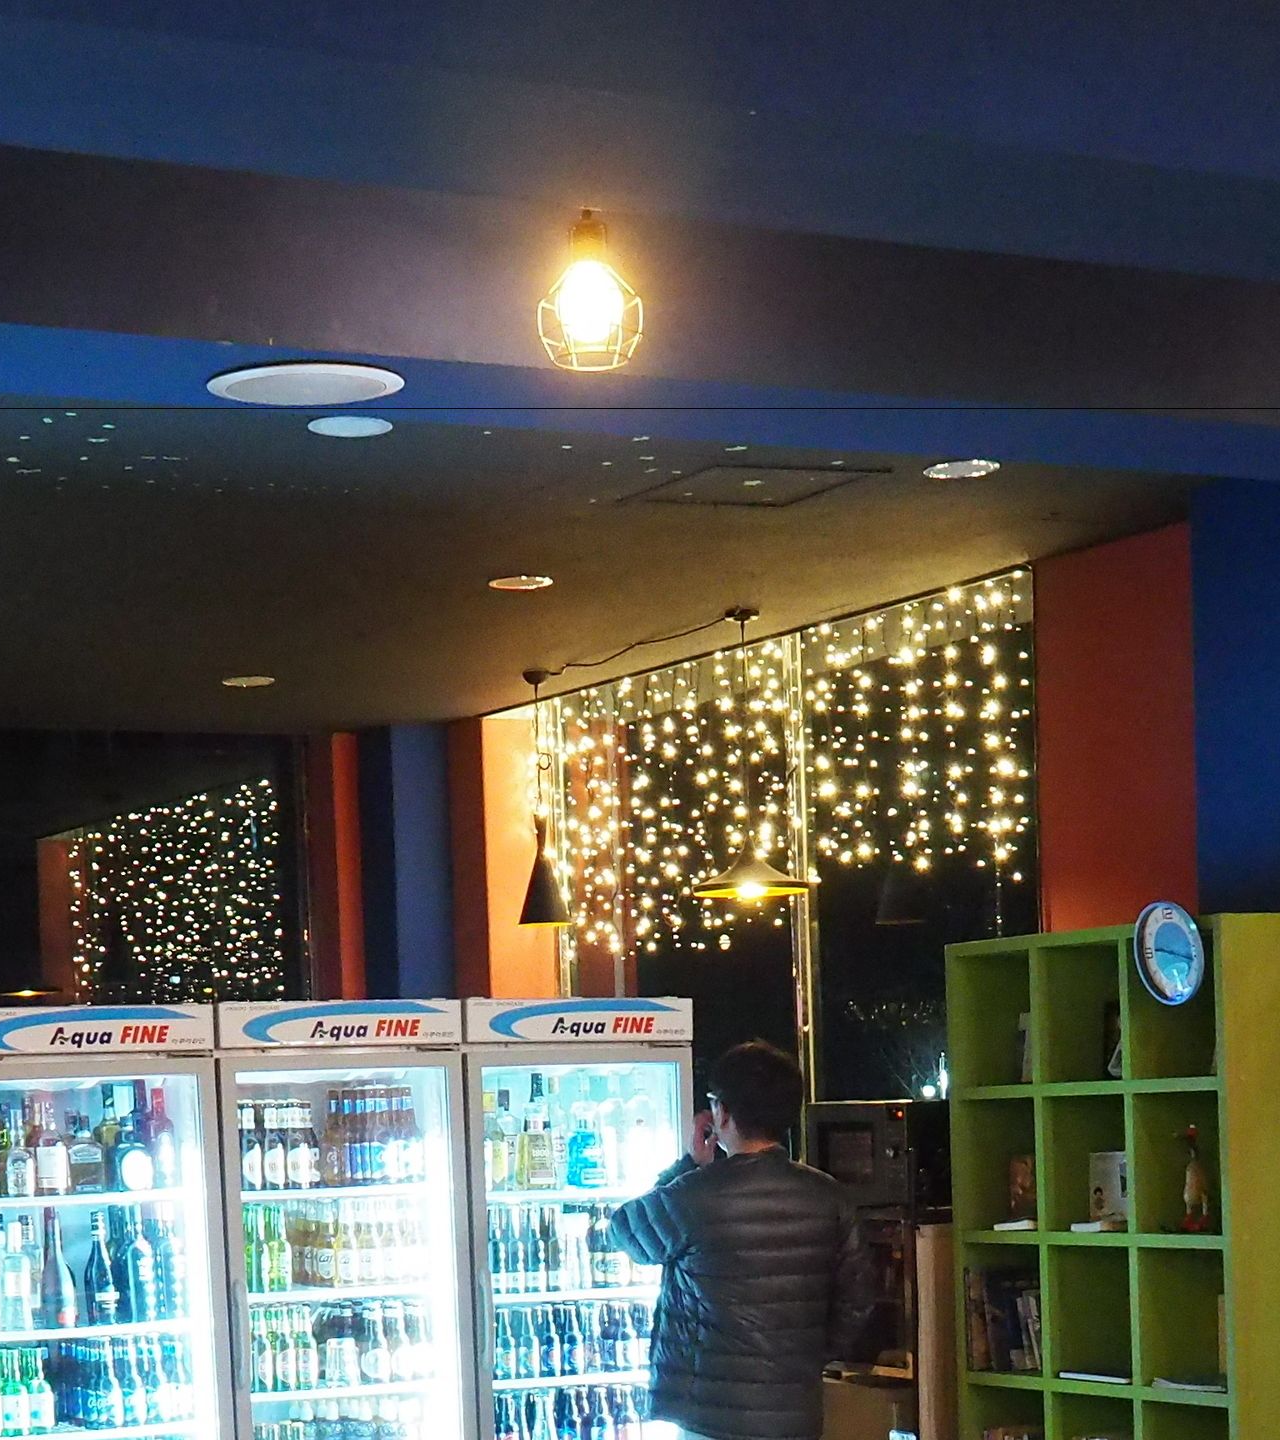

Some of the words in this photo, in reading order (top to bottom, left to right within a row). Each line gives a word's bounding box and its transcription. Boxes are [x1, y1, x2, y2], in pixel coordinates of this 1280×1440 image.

[49, 1026, 112, 1048] Aqua
[120, 1025, 170, 1044] FINE
[310, 1020, 369, 1042] Aqua
[375, 1019, 421, 1037] FINE
[551, 1016, 607, 1037] Aqua
[612, 1016, 655, 1034] FINE
